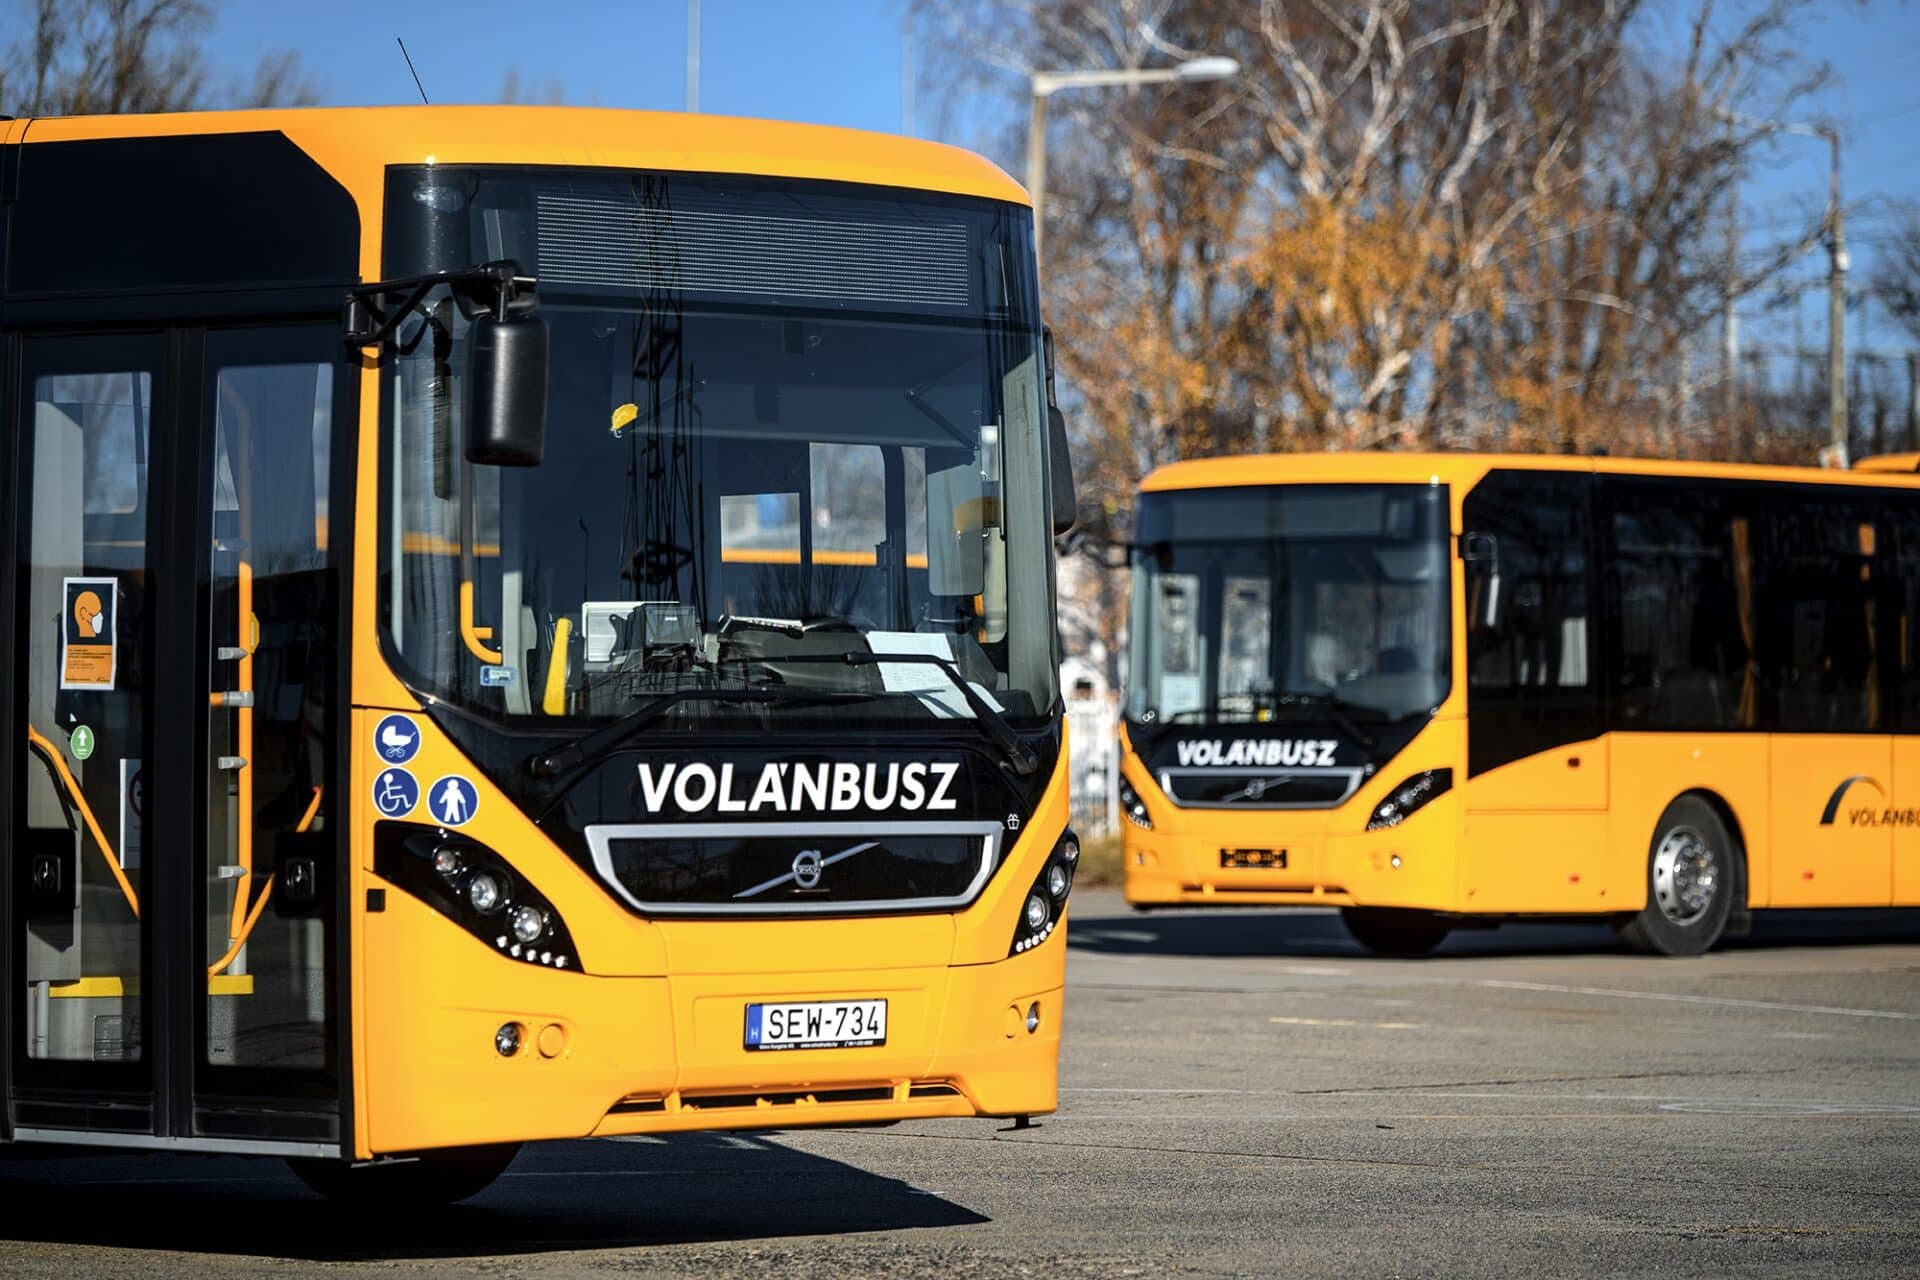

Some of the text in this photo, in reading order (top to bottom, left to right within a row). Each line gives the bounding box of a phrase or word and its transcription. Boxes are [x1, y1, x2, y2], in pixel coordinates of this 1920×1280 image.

[1177, 739, 1339, 767] VOLÁNBUSZ
[638, 762, 960, 812] VOLÁNBUSZ
[751, 1028, 759, 1039] H
[768, 1006, 879, 1040] SEW-734
